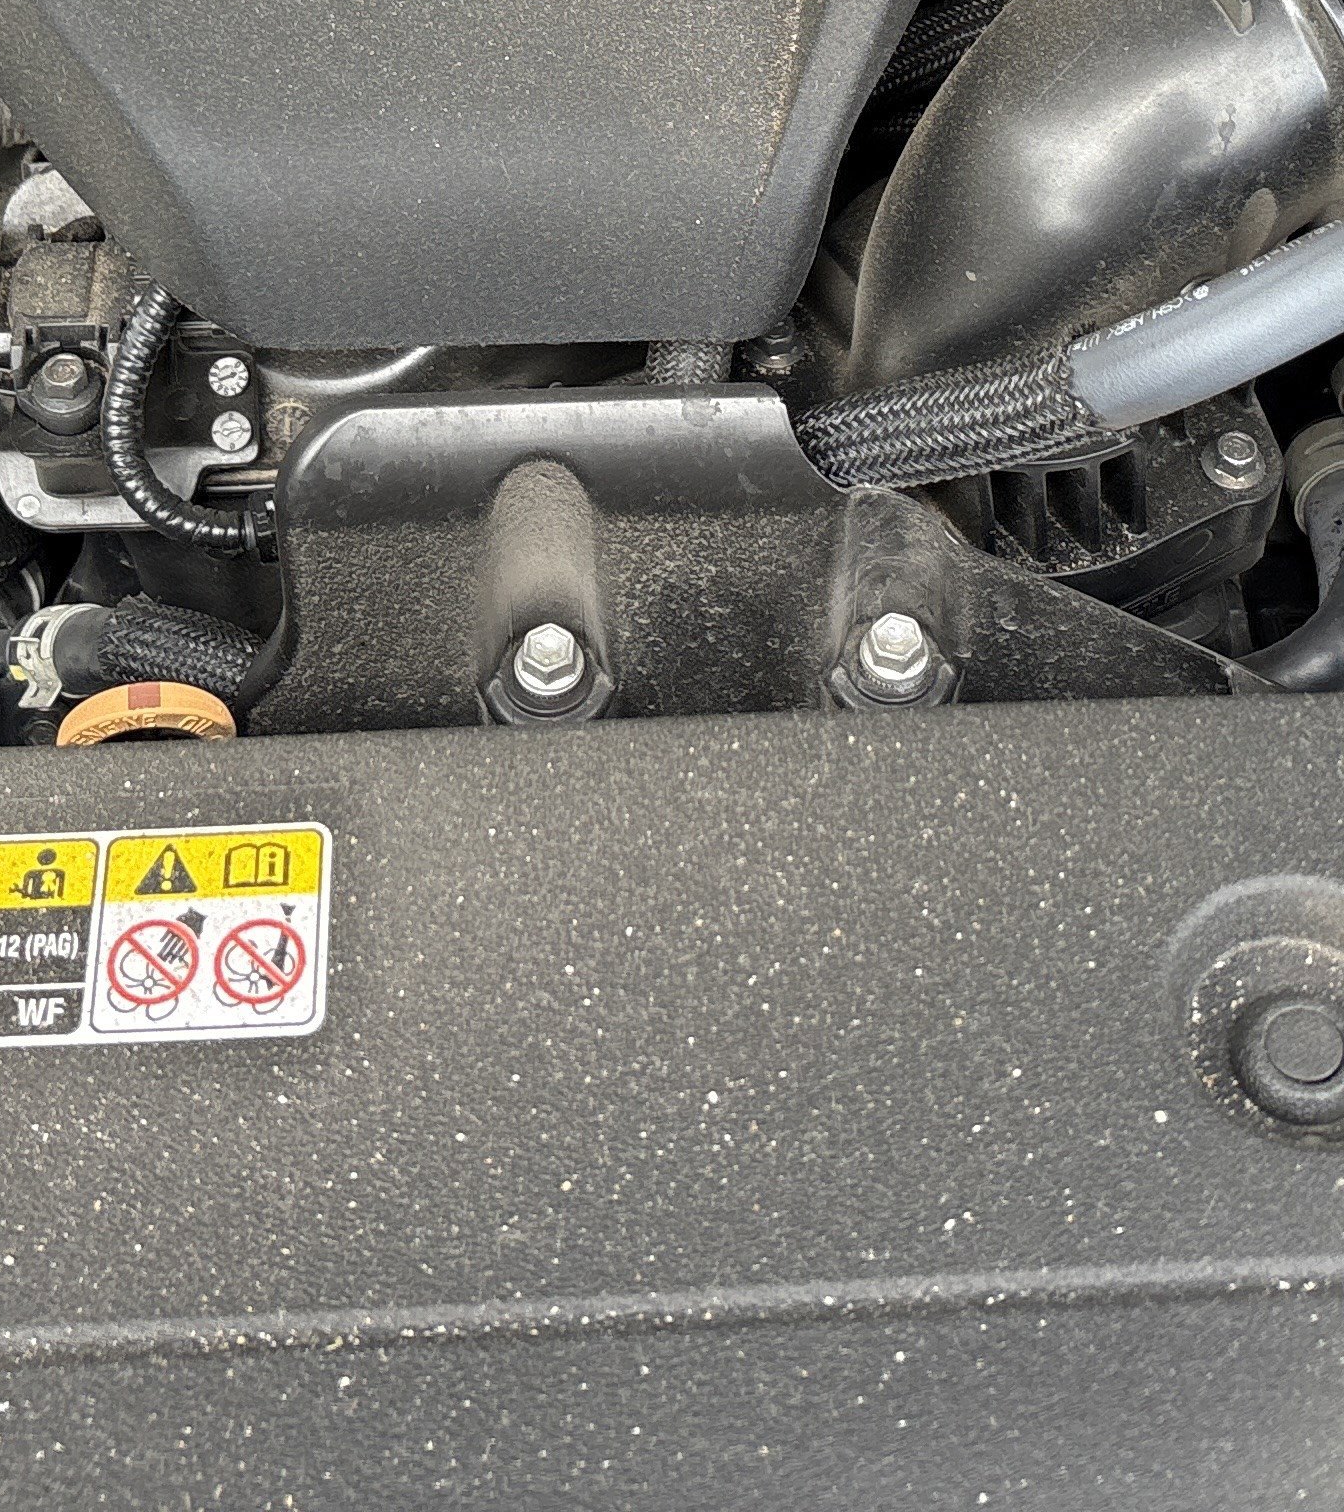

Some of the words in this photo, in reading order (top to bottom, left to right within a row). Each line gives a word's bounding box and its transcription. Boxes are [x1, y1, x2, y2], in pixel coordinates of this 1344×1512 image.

[69, 712, 157, 746] ENGINE
[24, 931, 80, 962] (PAG)
[17, 997, 66, 1027] WF
